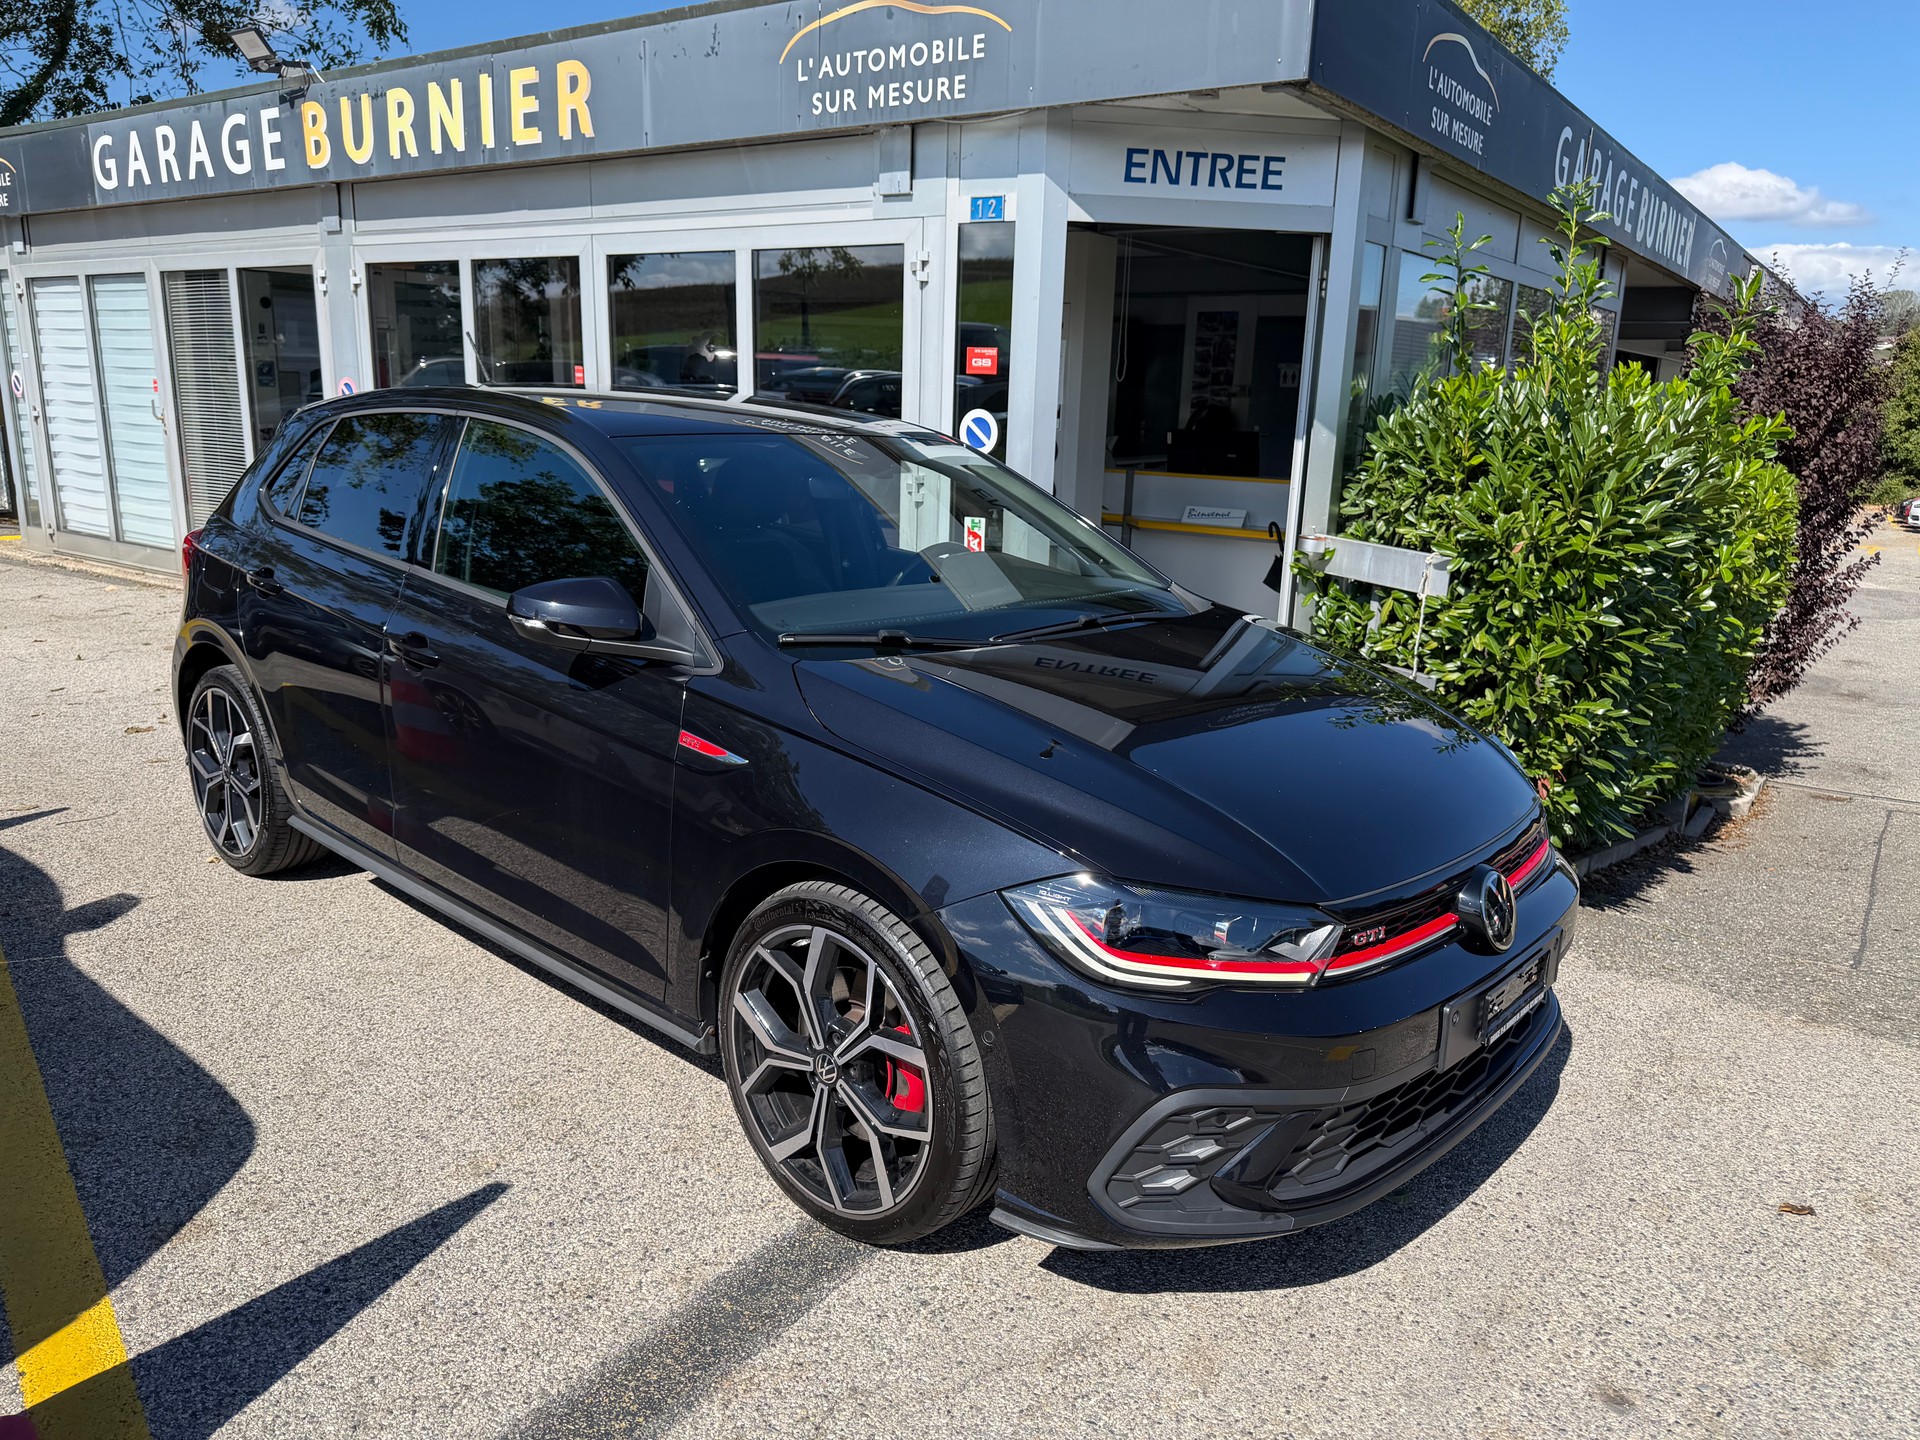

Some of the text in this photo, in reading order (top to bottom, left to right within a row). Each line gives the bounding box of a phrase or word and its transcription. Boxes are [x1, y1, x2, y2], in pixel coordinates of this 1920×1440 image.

[797, 33, 986, 82] L'AUTOMOBILE
[811, 74, 966, 115] SUR MESURE
[1428, 65, 1493, 127] L'AUTOMOBILE
[93, 59, 595, 191] GARAGE BURNIER
[1430, 106, 1484, 155] SUR MESURE
[1123, 147, 1287, 191] ENTREE
[976, 199, 997, 219] 12
[1554, 126, 1695, 268] GARAGE BURNIER
[1354, 925, 1387, 947] GTI
